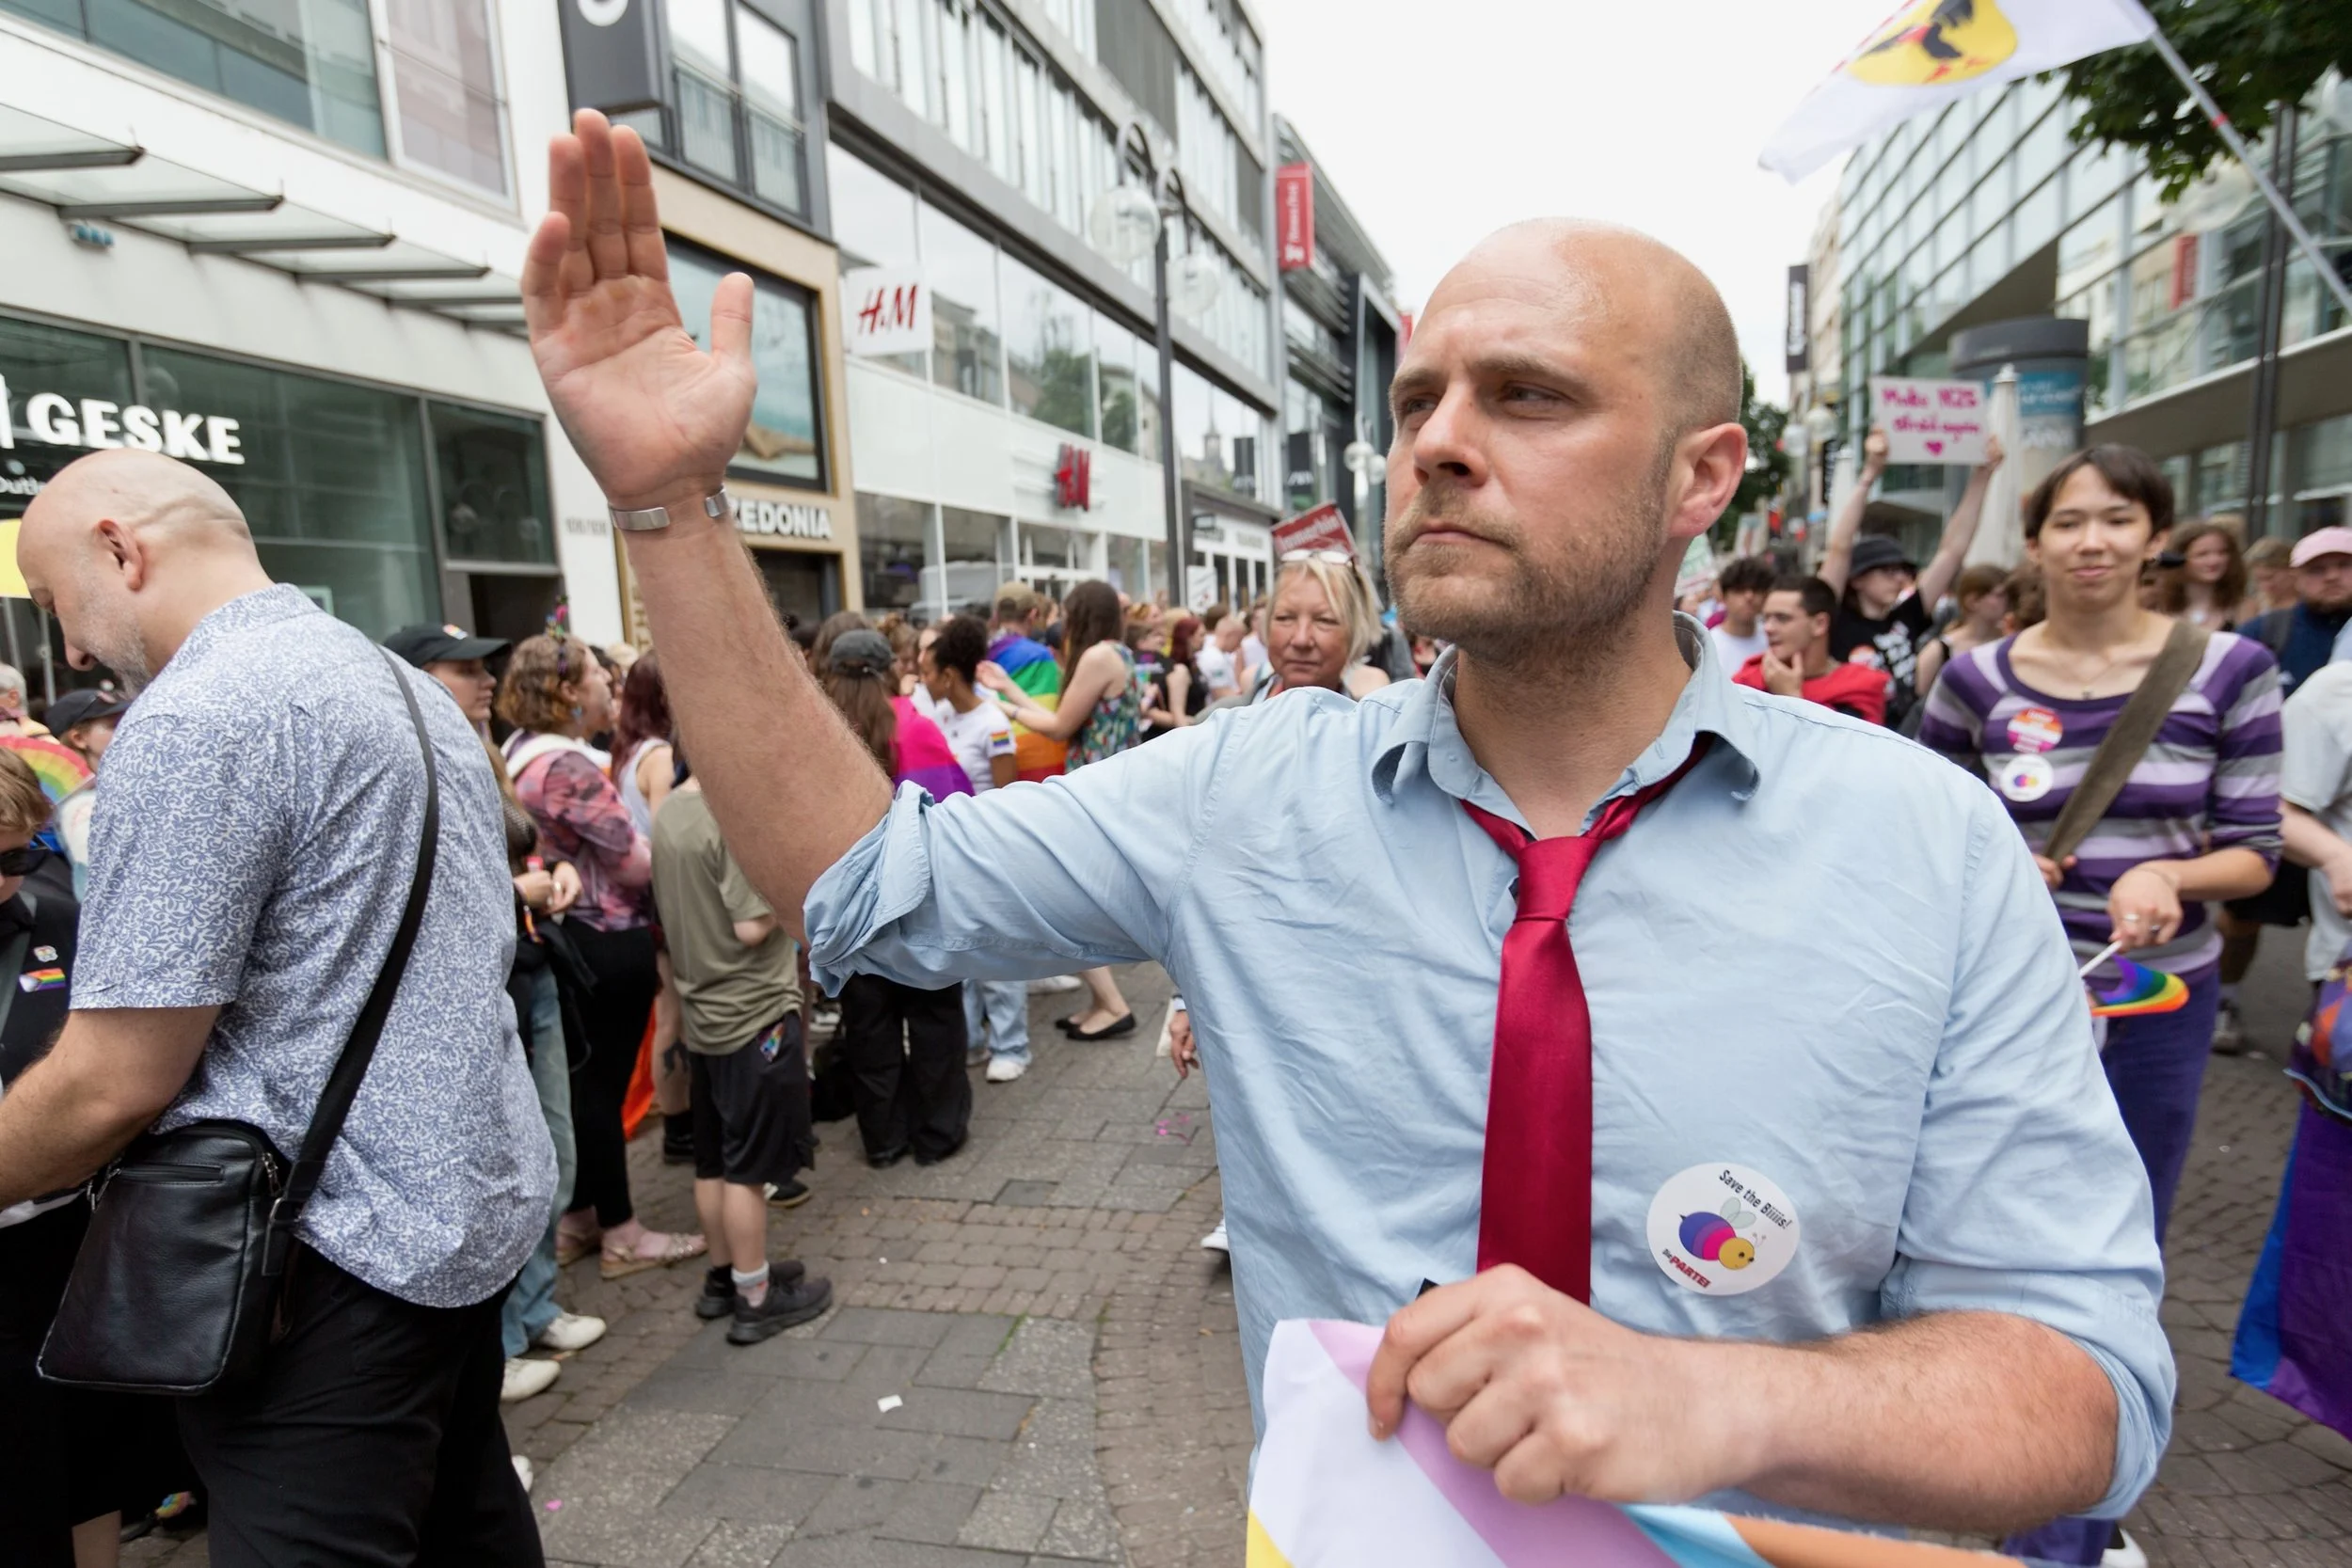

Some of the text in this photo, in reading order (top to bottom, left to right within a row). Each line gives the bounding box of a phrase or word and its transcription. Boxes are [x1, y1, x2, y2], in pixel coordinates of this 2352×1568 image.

[26, 392, 245, 465] GESKE
[1719, 1169, 1744, 1194] Save
[1743, 1189, 1761, 1208] the
[1669, 1256, 1710, 1289] PARTEI
